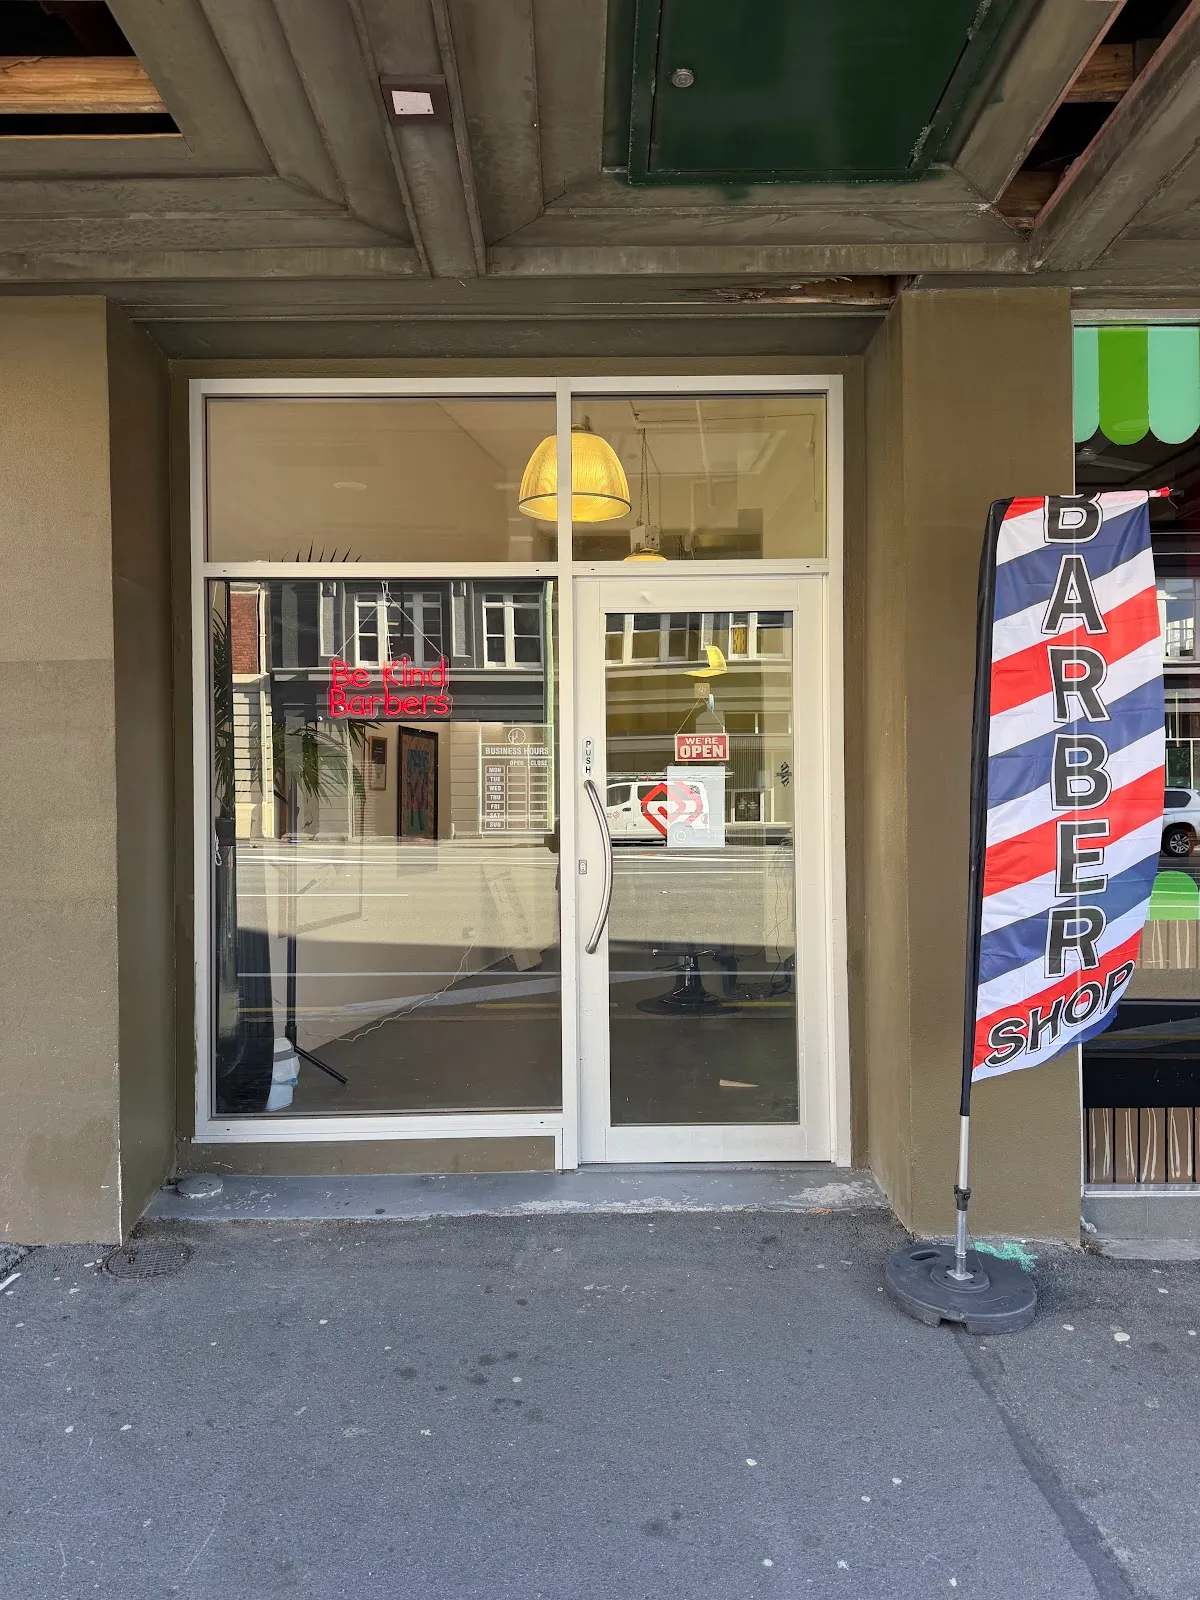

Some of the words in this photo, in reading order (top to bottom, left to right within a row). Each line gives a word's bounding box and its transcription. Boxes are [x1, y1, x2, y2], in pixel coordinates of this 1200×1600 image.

[332, 659, 370, 689] Be
[329, 687, 449, 717] Barbers
[485, 747, 522, 755] BUSINESS
[523, 747, 549, 755] HOURS
[679, 744, 724, 758] OPEN
[685, 737, 719, 745] WE'RE
[1041, 493, 1112, 979] BARBER
[984, 959, 1136, 1068] SHOP
